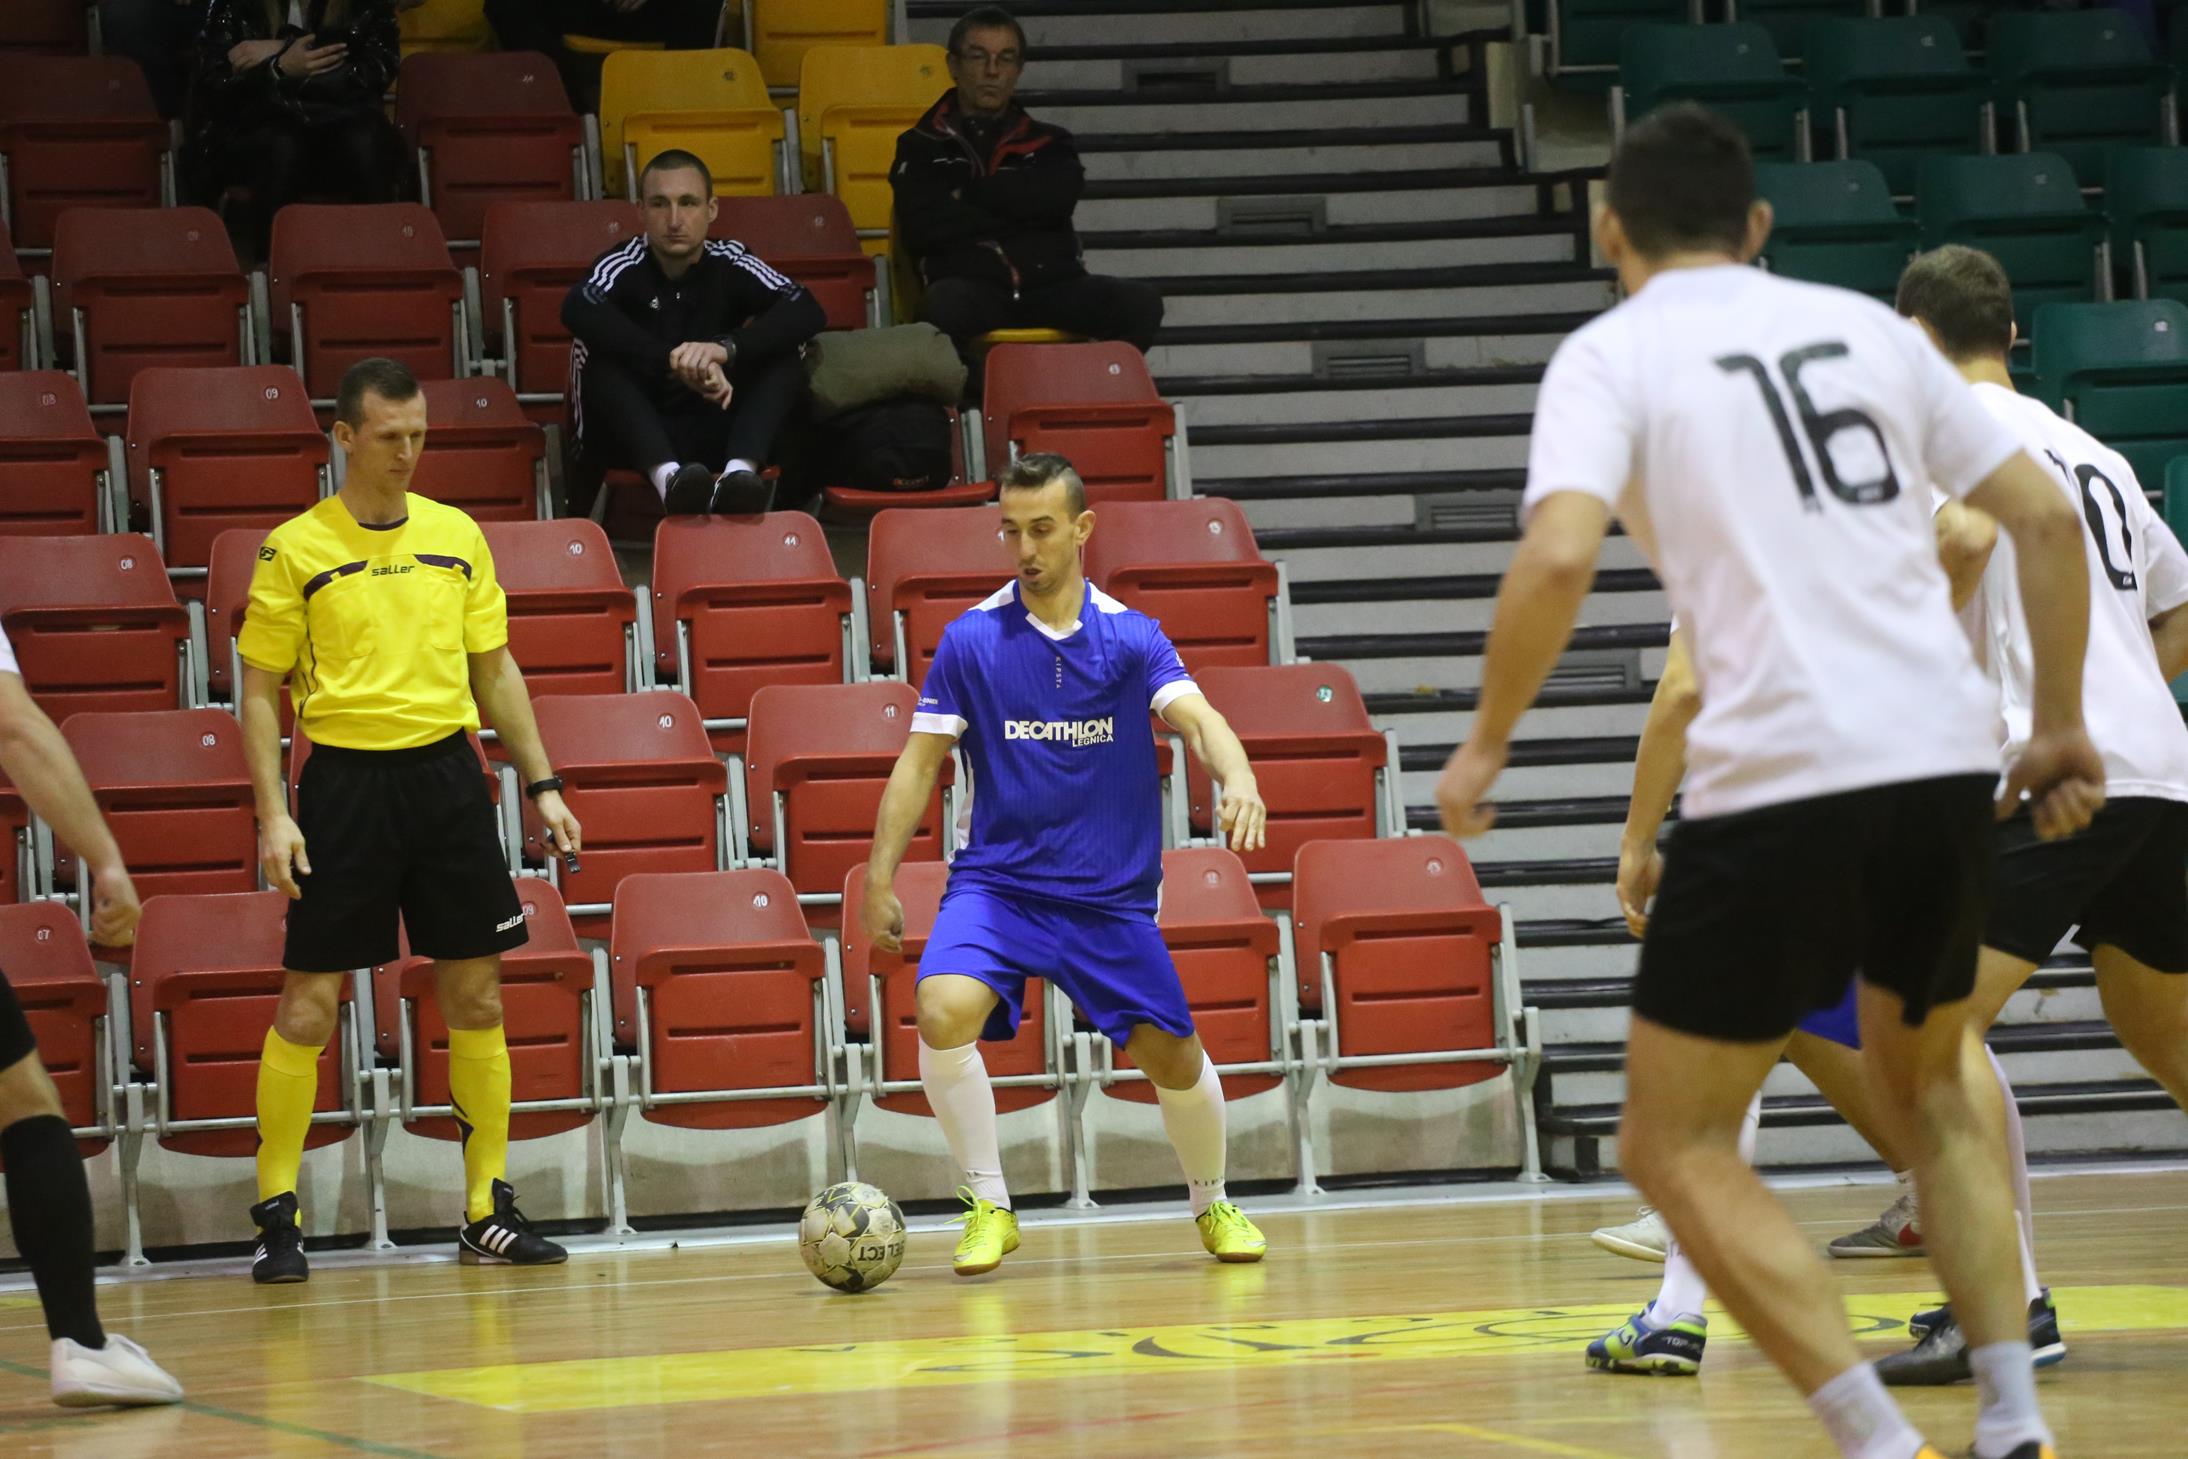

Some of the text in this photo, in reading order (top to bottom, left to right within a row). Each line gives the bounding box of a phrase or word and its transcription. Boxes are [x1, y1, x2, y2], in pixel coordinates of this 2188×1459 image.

[265, 388, 278, 401] 09
[476, 398, 488, 410] 10
[1714, 341, 1900, 515] 16
[570, 543, 583, 556] 10
[121, 559, 134, 571] 08
[371, 564, 415, 576] saller
[1055, 656, 1063, 689] KIPSTA
[885, 706, 896, 719] 11
[659, 714, 673, 728] 10
[1004, 716, 1113, 741] DECATHLON
[203, 734, 216, 747] 08
[1072, 734, 1114, 748] LEGNICA
[753, 896, 769, 909] 10
[38, 930, 50, 942] 07
